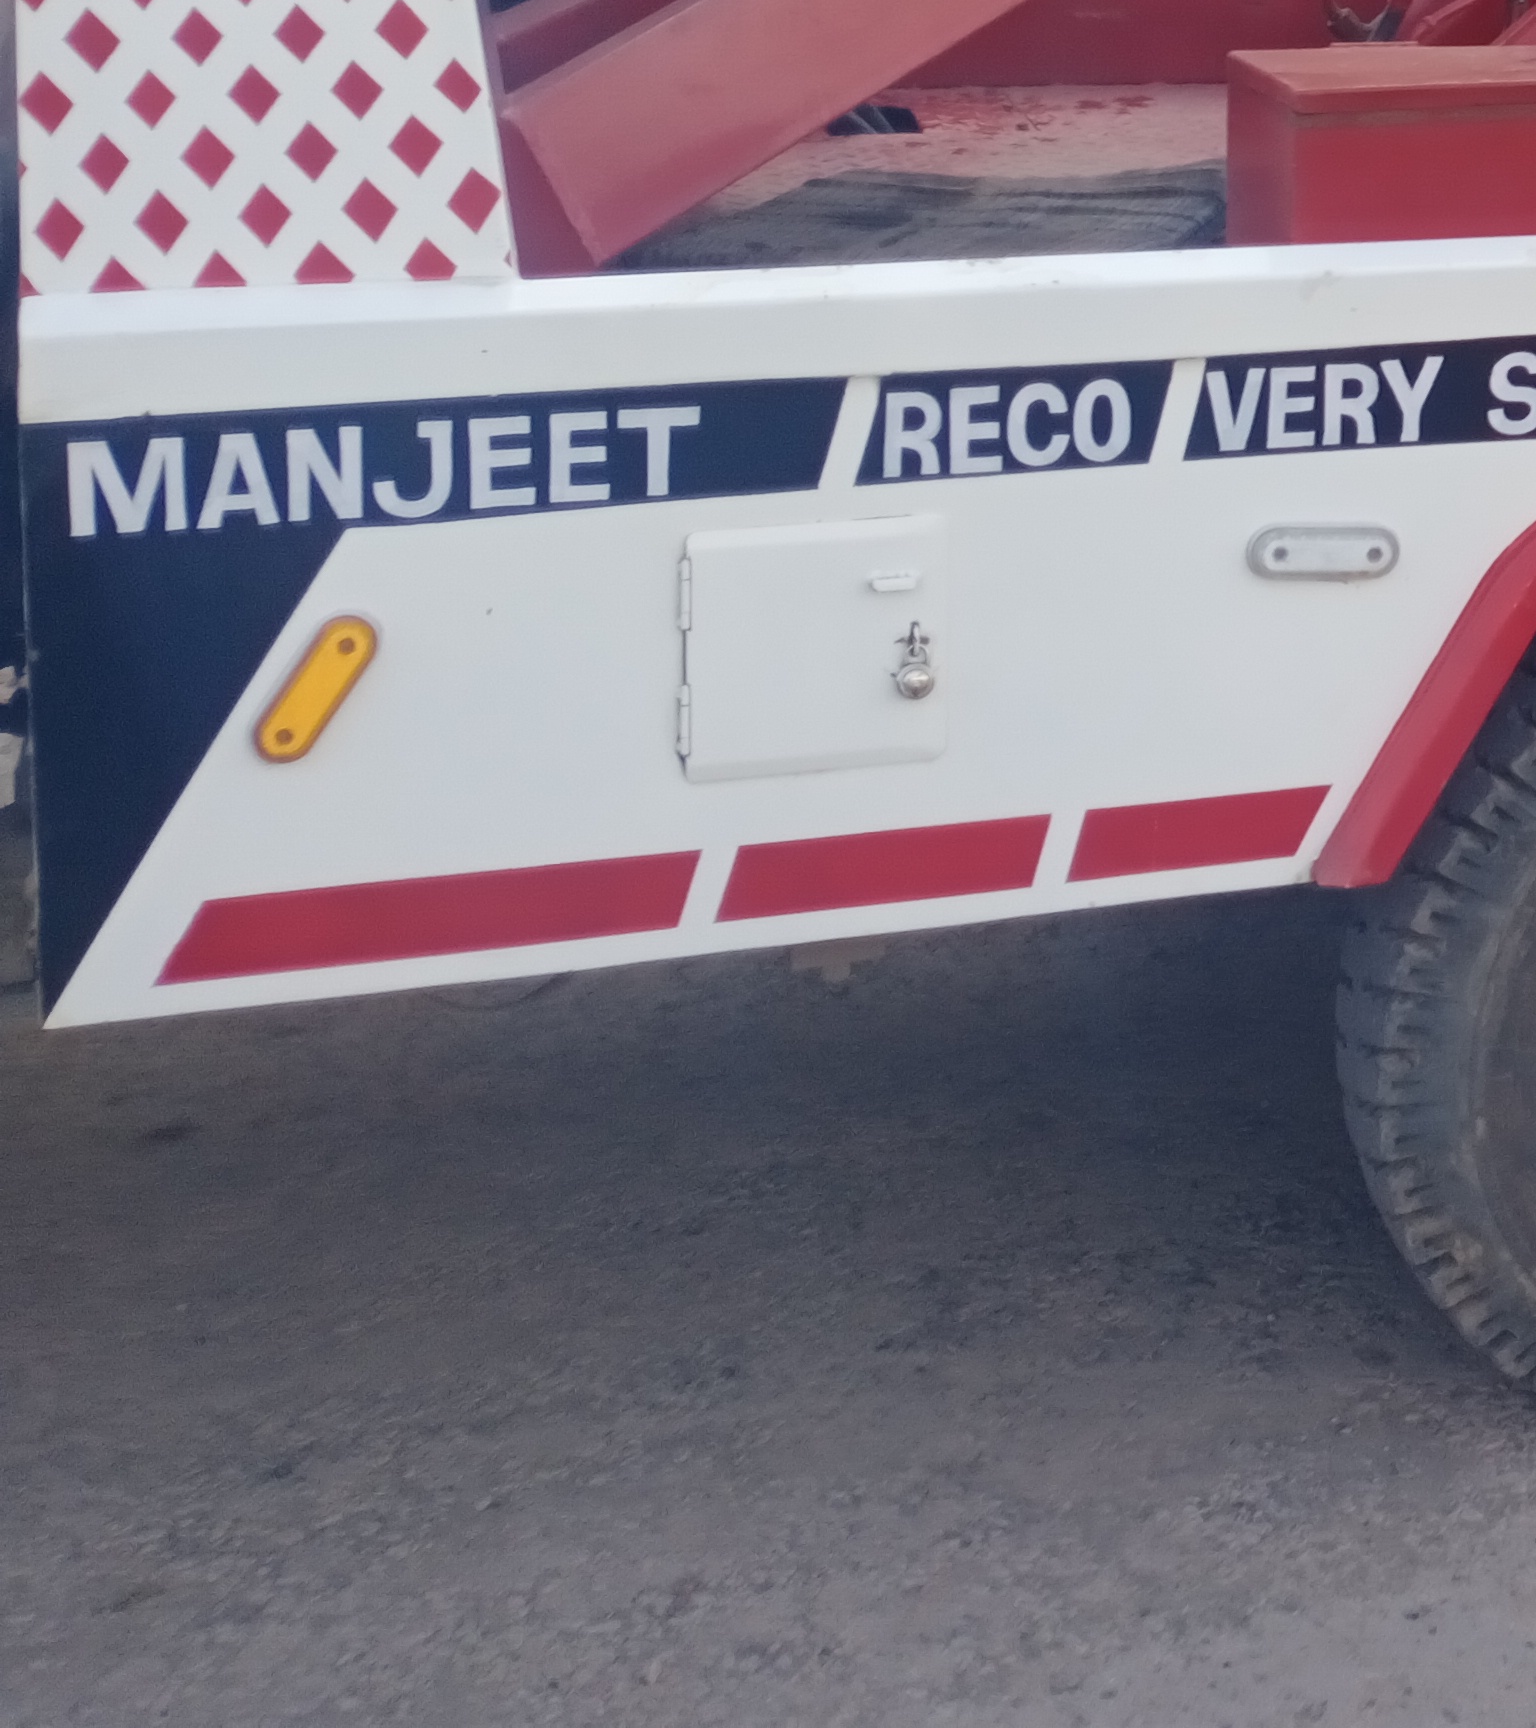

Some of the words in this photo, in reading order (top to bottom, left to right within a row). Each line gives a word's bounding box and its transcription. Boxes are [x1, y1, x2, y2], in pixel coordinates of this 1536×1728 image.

[65, 405, 702, 539] MANJEET
[882, 378, 1132, 478] RECO
[1205, 355, 1445, 452] VERY
